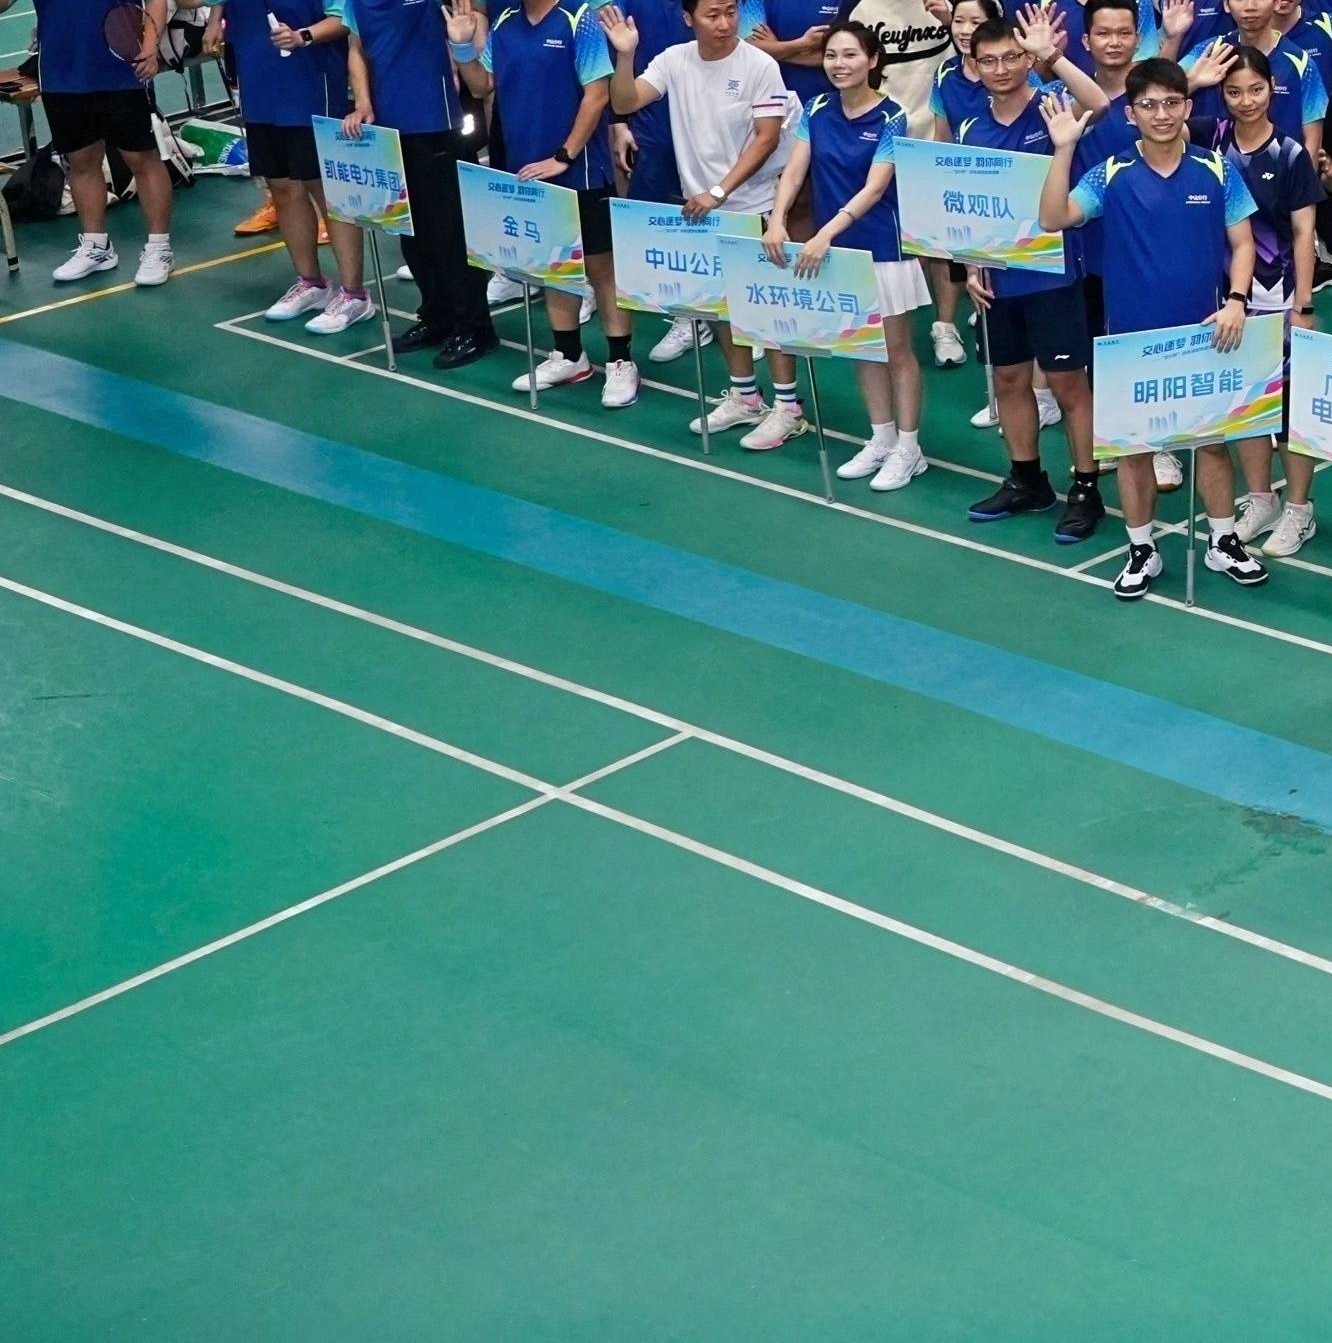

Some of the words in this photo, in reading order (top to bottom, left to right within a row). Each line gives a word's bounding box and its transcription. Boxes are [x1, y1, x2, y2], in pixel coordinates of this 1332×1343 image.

[324, 159, 401, 192] 凯能电力集团
[943, 189, 1014, 220] 微观队
[503, 215, 541, 243] 金马
[746, 283, 860, 316] 水环境公司
[1190, 331, 1215, 348] 羽你
[1134, 368, 1244, 404] 明阳智能
